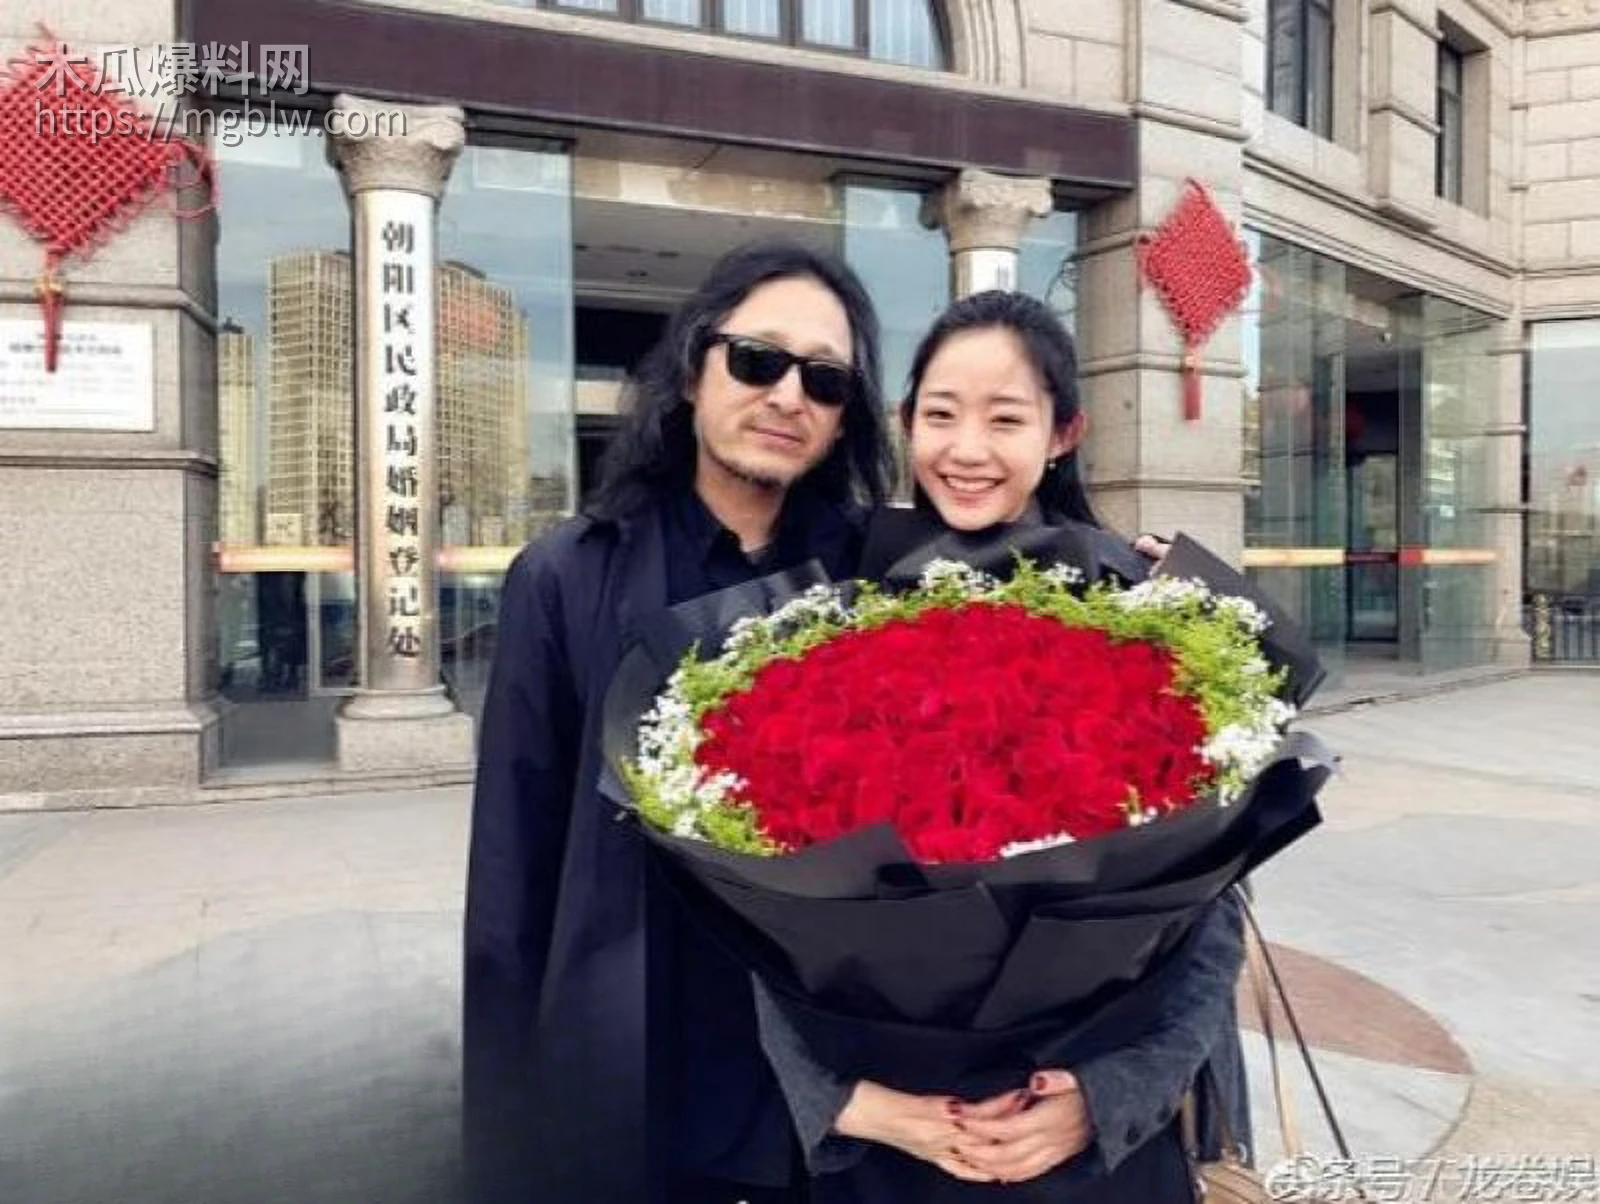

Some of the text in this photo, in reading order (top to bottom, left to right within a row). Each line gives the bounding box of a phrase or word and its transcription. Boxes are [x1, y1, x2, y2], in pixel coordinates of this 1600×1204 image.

[382, 220, 420, 658] 朝阳区民政局婚姻登记处
